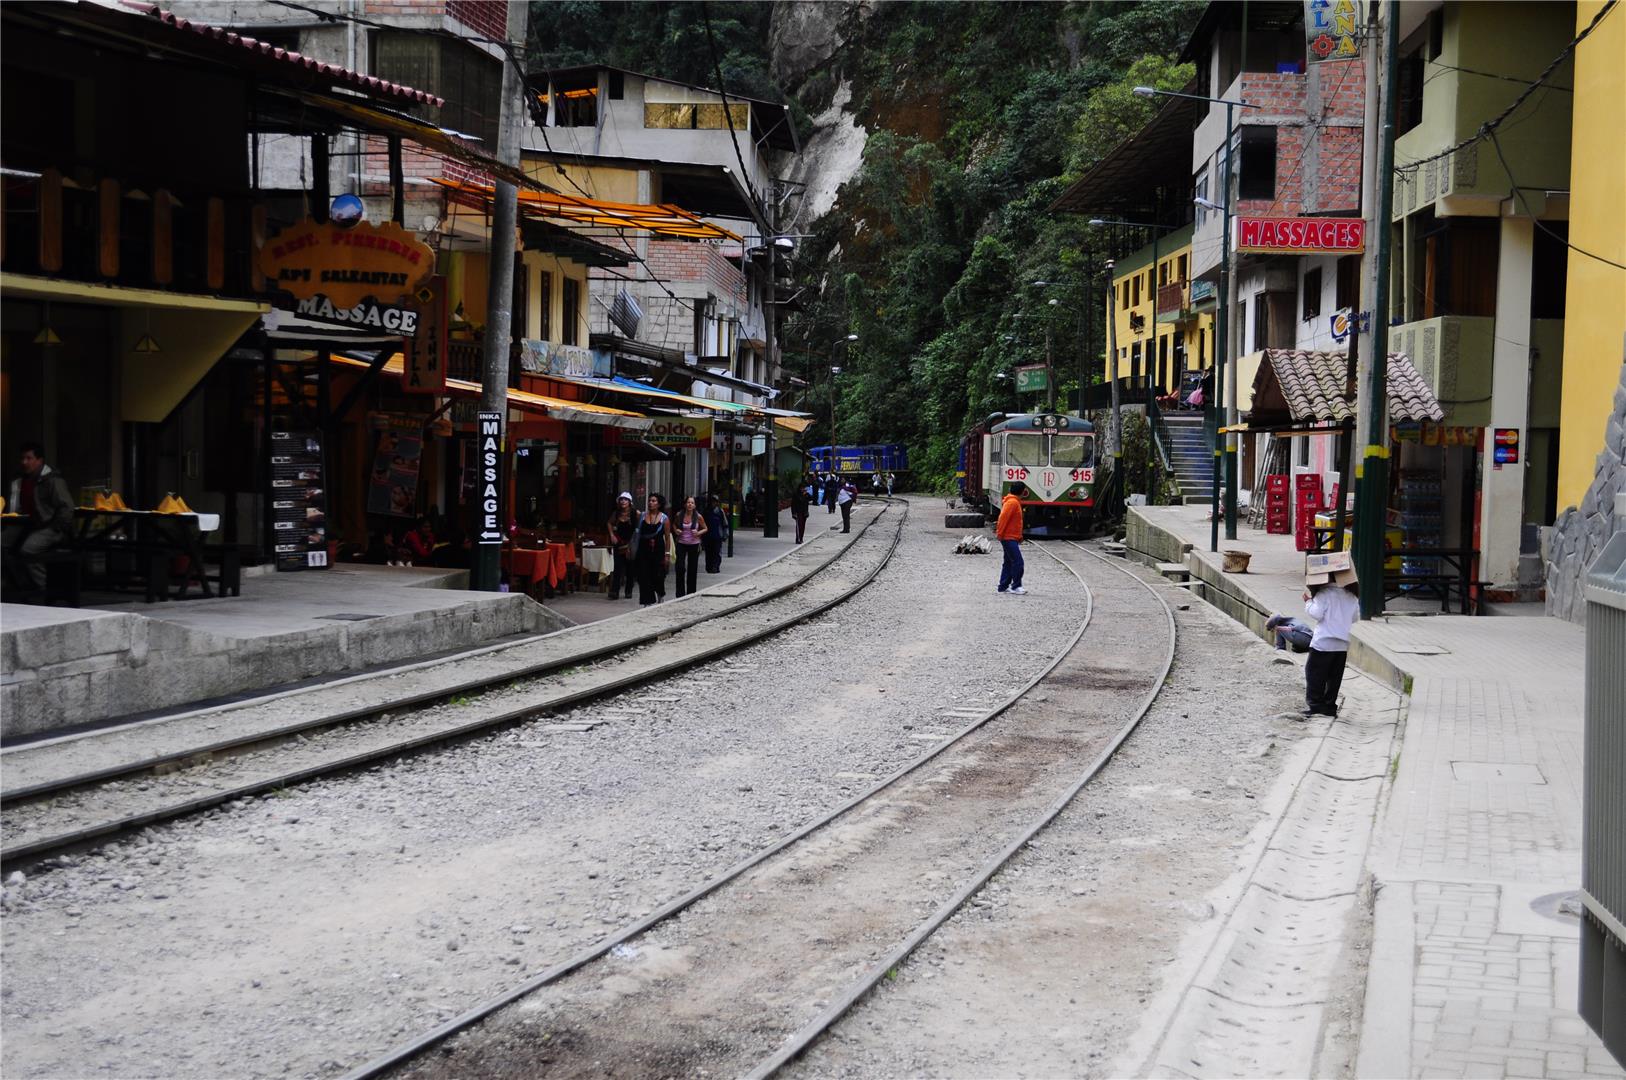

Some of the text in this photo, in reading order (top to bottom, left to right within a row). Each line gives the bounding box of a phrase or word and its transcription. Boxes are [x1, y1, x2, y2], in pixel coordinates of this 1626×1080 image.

[330, 231, 420, 265] PIZZERIA
[1240, 220, 1361, 248] MASSAGES
[280, 269, 408, 286] APU SALKANTAY
[297, 296, 416, 332] MASSAGE
[482, 421, 499, 528] MASSAGE
[1006, 468, 1027, 481] 915
[1071, 470, 1092, 482] 915
